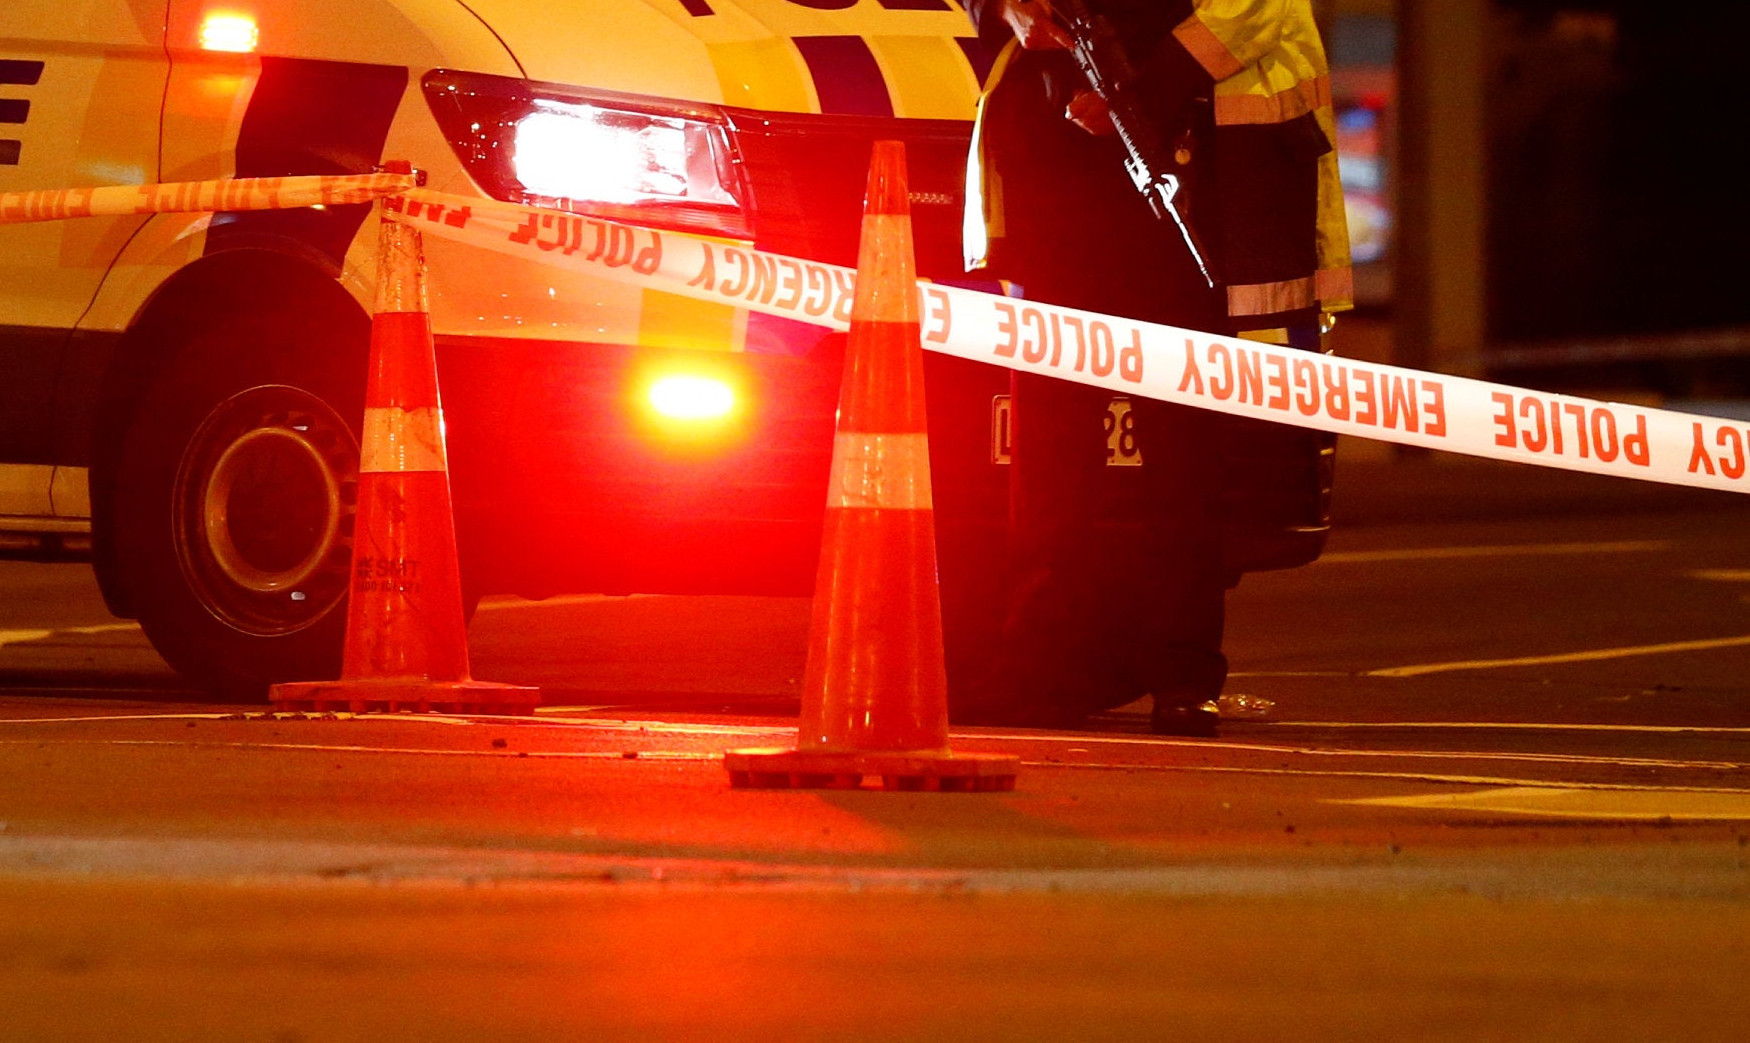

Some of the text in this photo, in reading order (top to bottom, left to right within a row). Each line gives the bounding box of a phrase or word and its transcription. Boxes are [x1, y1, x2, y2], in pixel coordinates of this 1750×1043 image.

[688, 242, 952, 345] ERGENCY
[993, 301, 1143, 384] POLICE
[1178, 339, 1447, 438] EMERGENCY
[1491, 392, 1650, 467] POLICE
